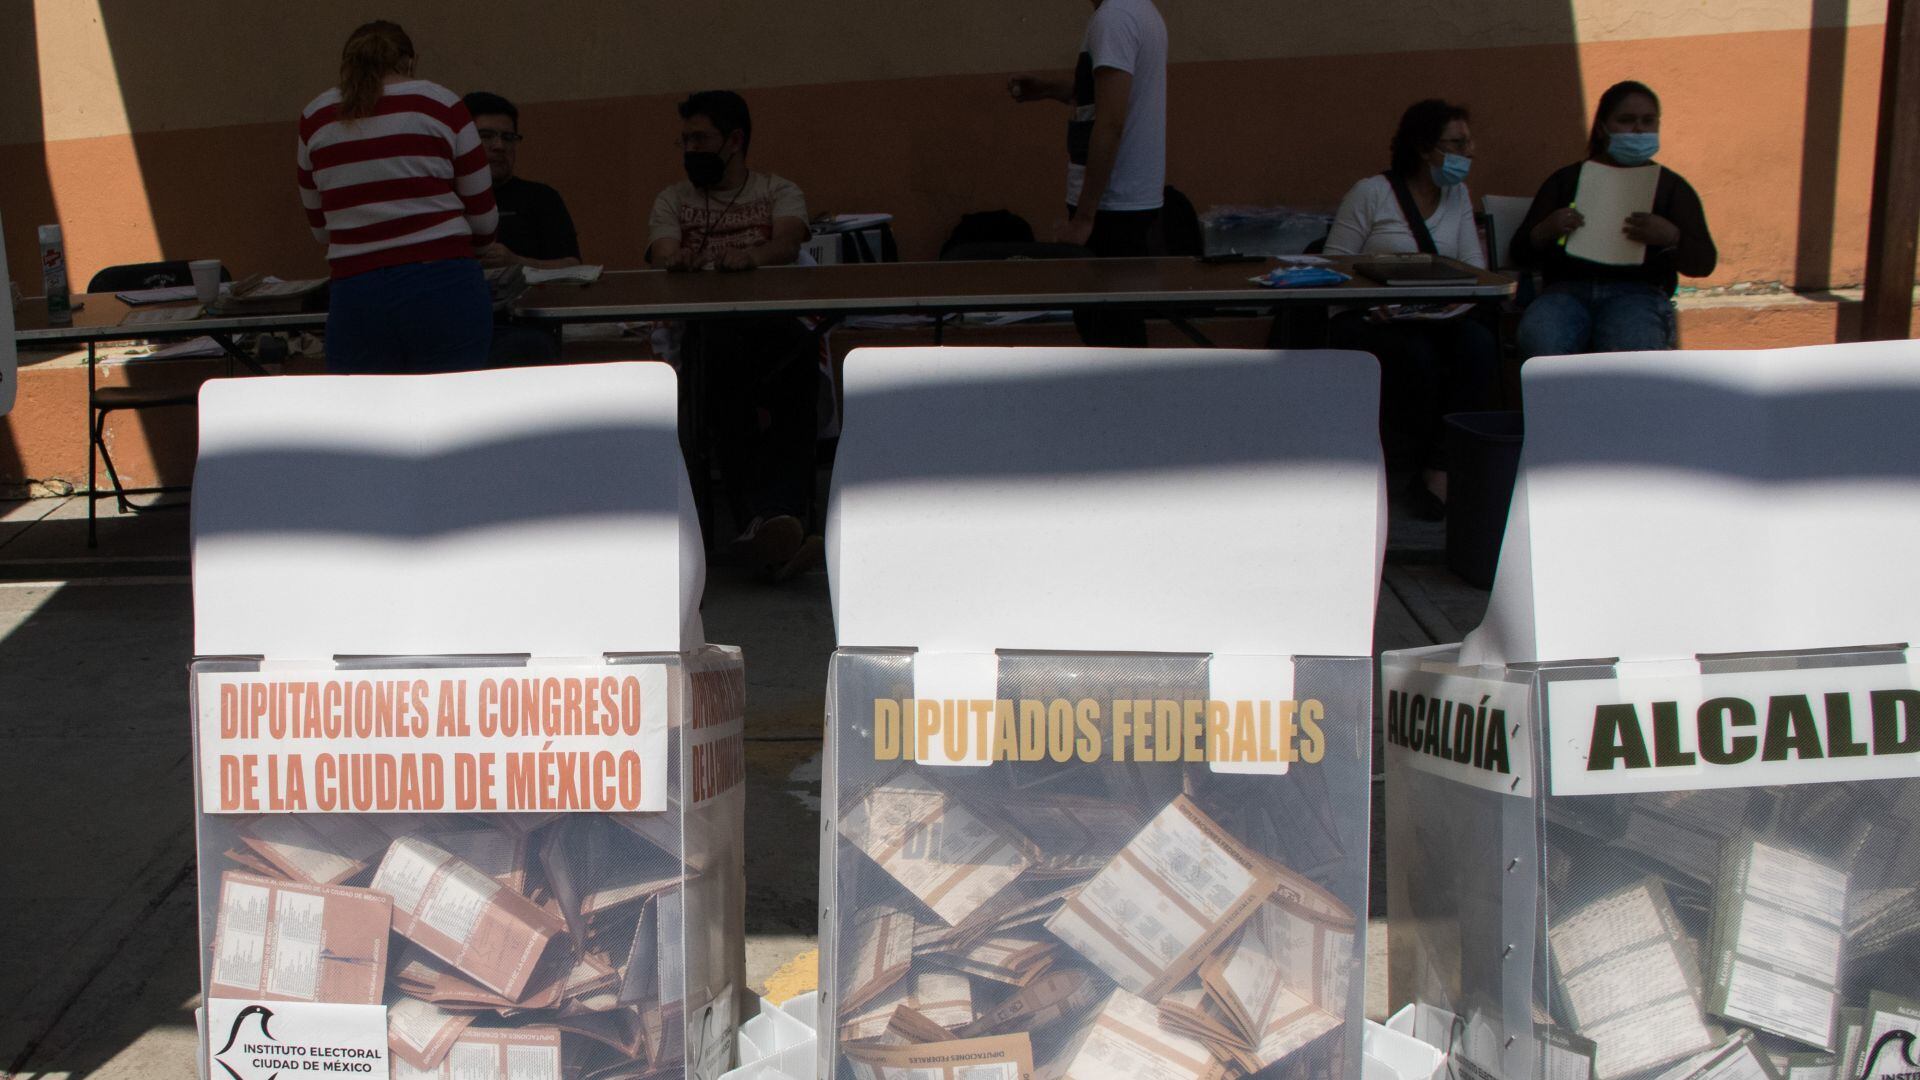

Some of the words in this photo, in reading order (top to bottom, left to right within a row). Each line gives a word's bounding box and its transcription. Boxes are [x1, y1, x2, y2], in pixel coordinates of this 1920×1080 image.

[220, 680, 429, 739] DIPUTACIONES
[436, 679, 470, 738] AL
[478, 676, 640, 738] CONGRESO
[874, 698, 1100, 763] DIPUTADOS
[1113, 699, 1325, 763] FEDERALES
[1388, 689, 1510, 774] ALCALDÍA
[1586, 688, 1920, 771] ALCALD
[220, 754, 259, 811] DE
[268, 753, 307, 810] LA
[315, 752, 444, 811] CIUDAD
[454, 752, 495, 809] DE
[506, 741, 641, 811] MÉXICO
[244, 1044, 306, 1056] INSTITUTO
[310, 1047, 382, 1059] ELECTORAL
[252, 1059, 299, 1069] CIUDAD
[303, 1061, 319, 1070] DE
[324, 1060, 372, 1072] MÉXICO
